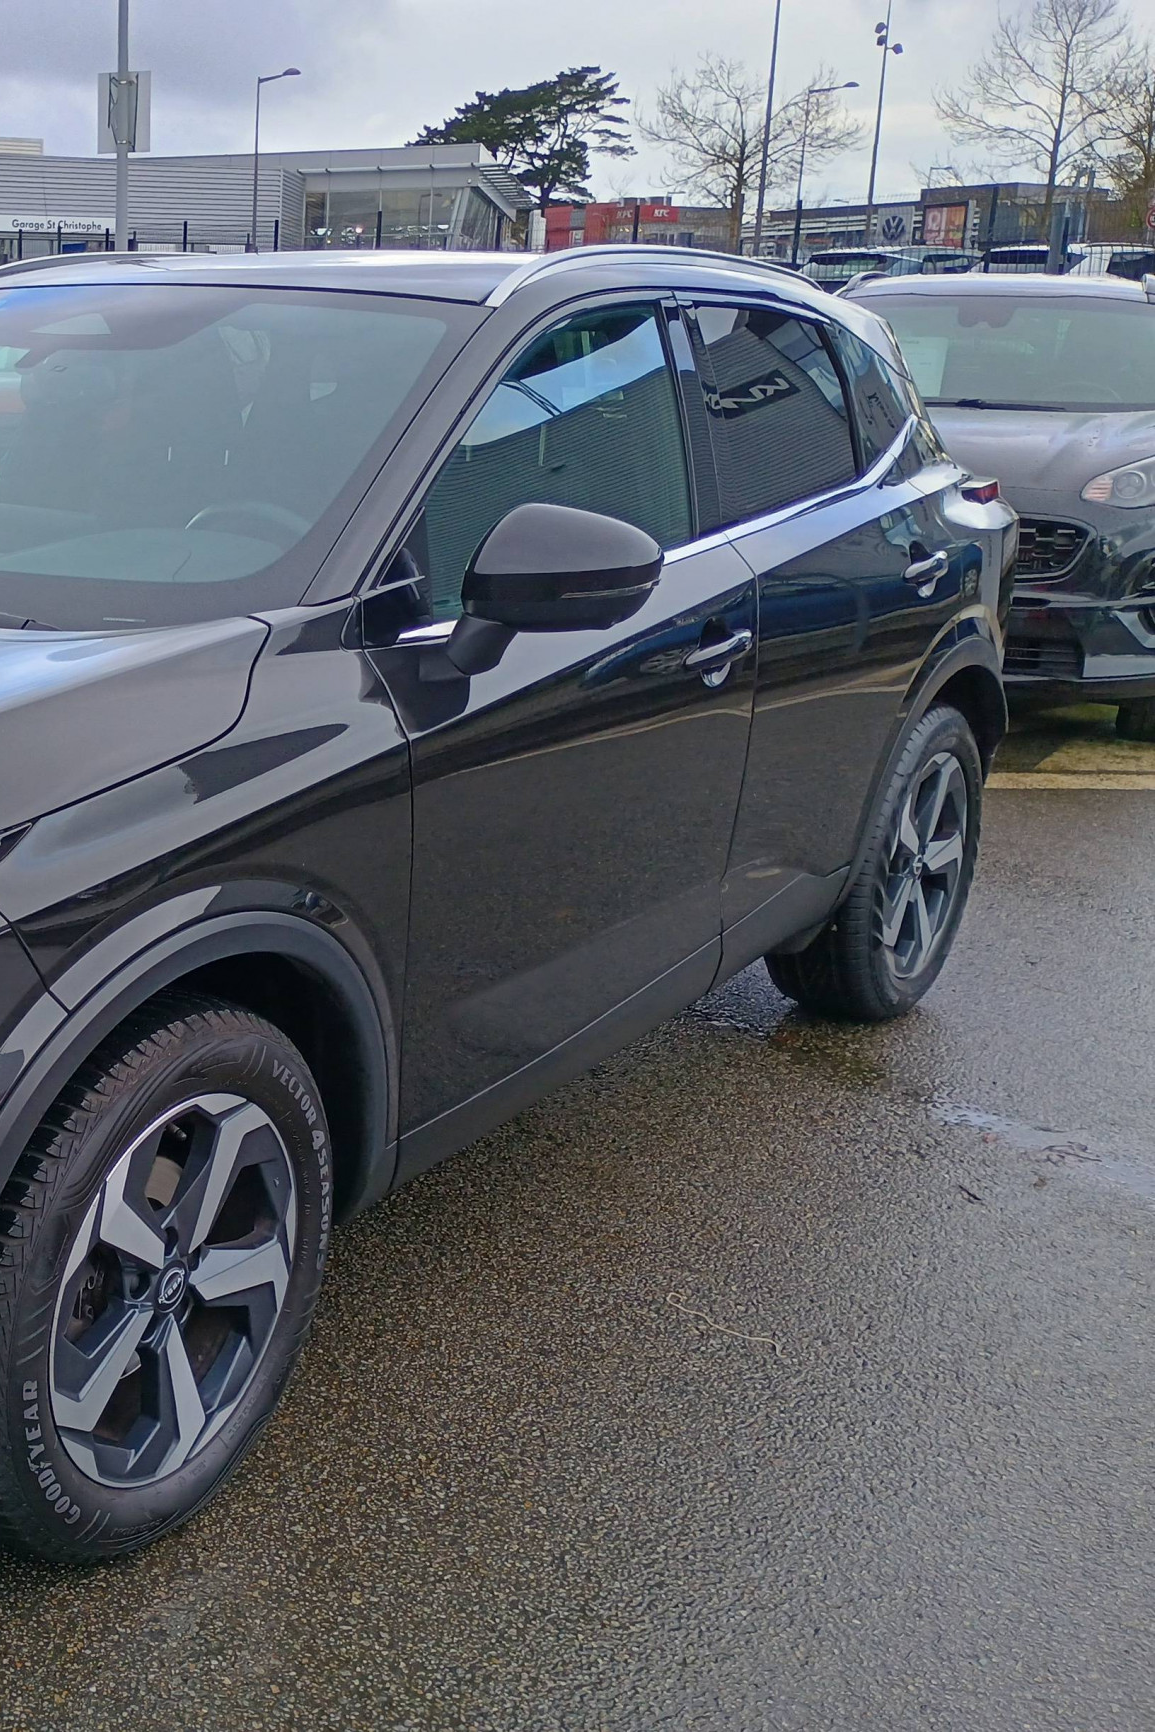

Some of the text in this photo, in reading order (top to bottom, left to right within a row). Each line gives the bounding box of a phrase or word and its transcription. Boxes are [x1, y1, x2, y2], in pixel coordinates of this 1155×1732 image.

[11, 219, 102, 232] Garage St Christophe
[653, 208, 671, 218] KFC
[272, 1058, 318, 1127] VECTOR
[22, 1380, 81, 1525] GOODYEAR
